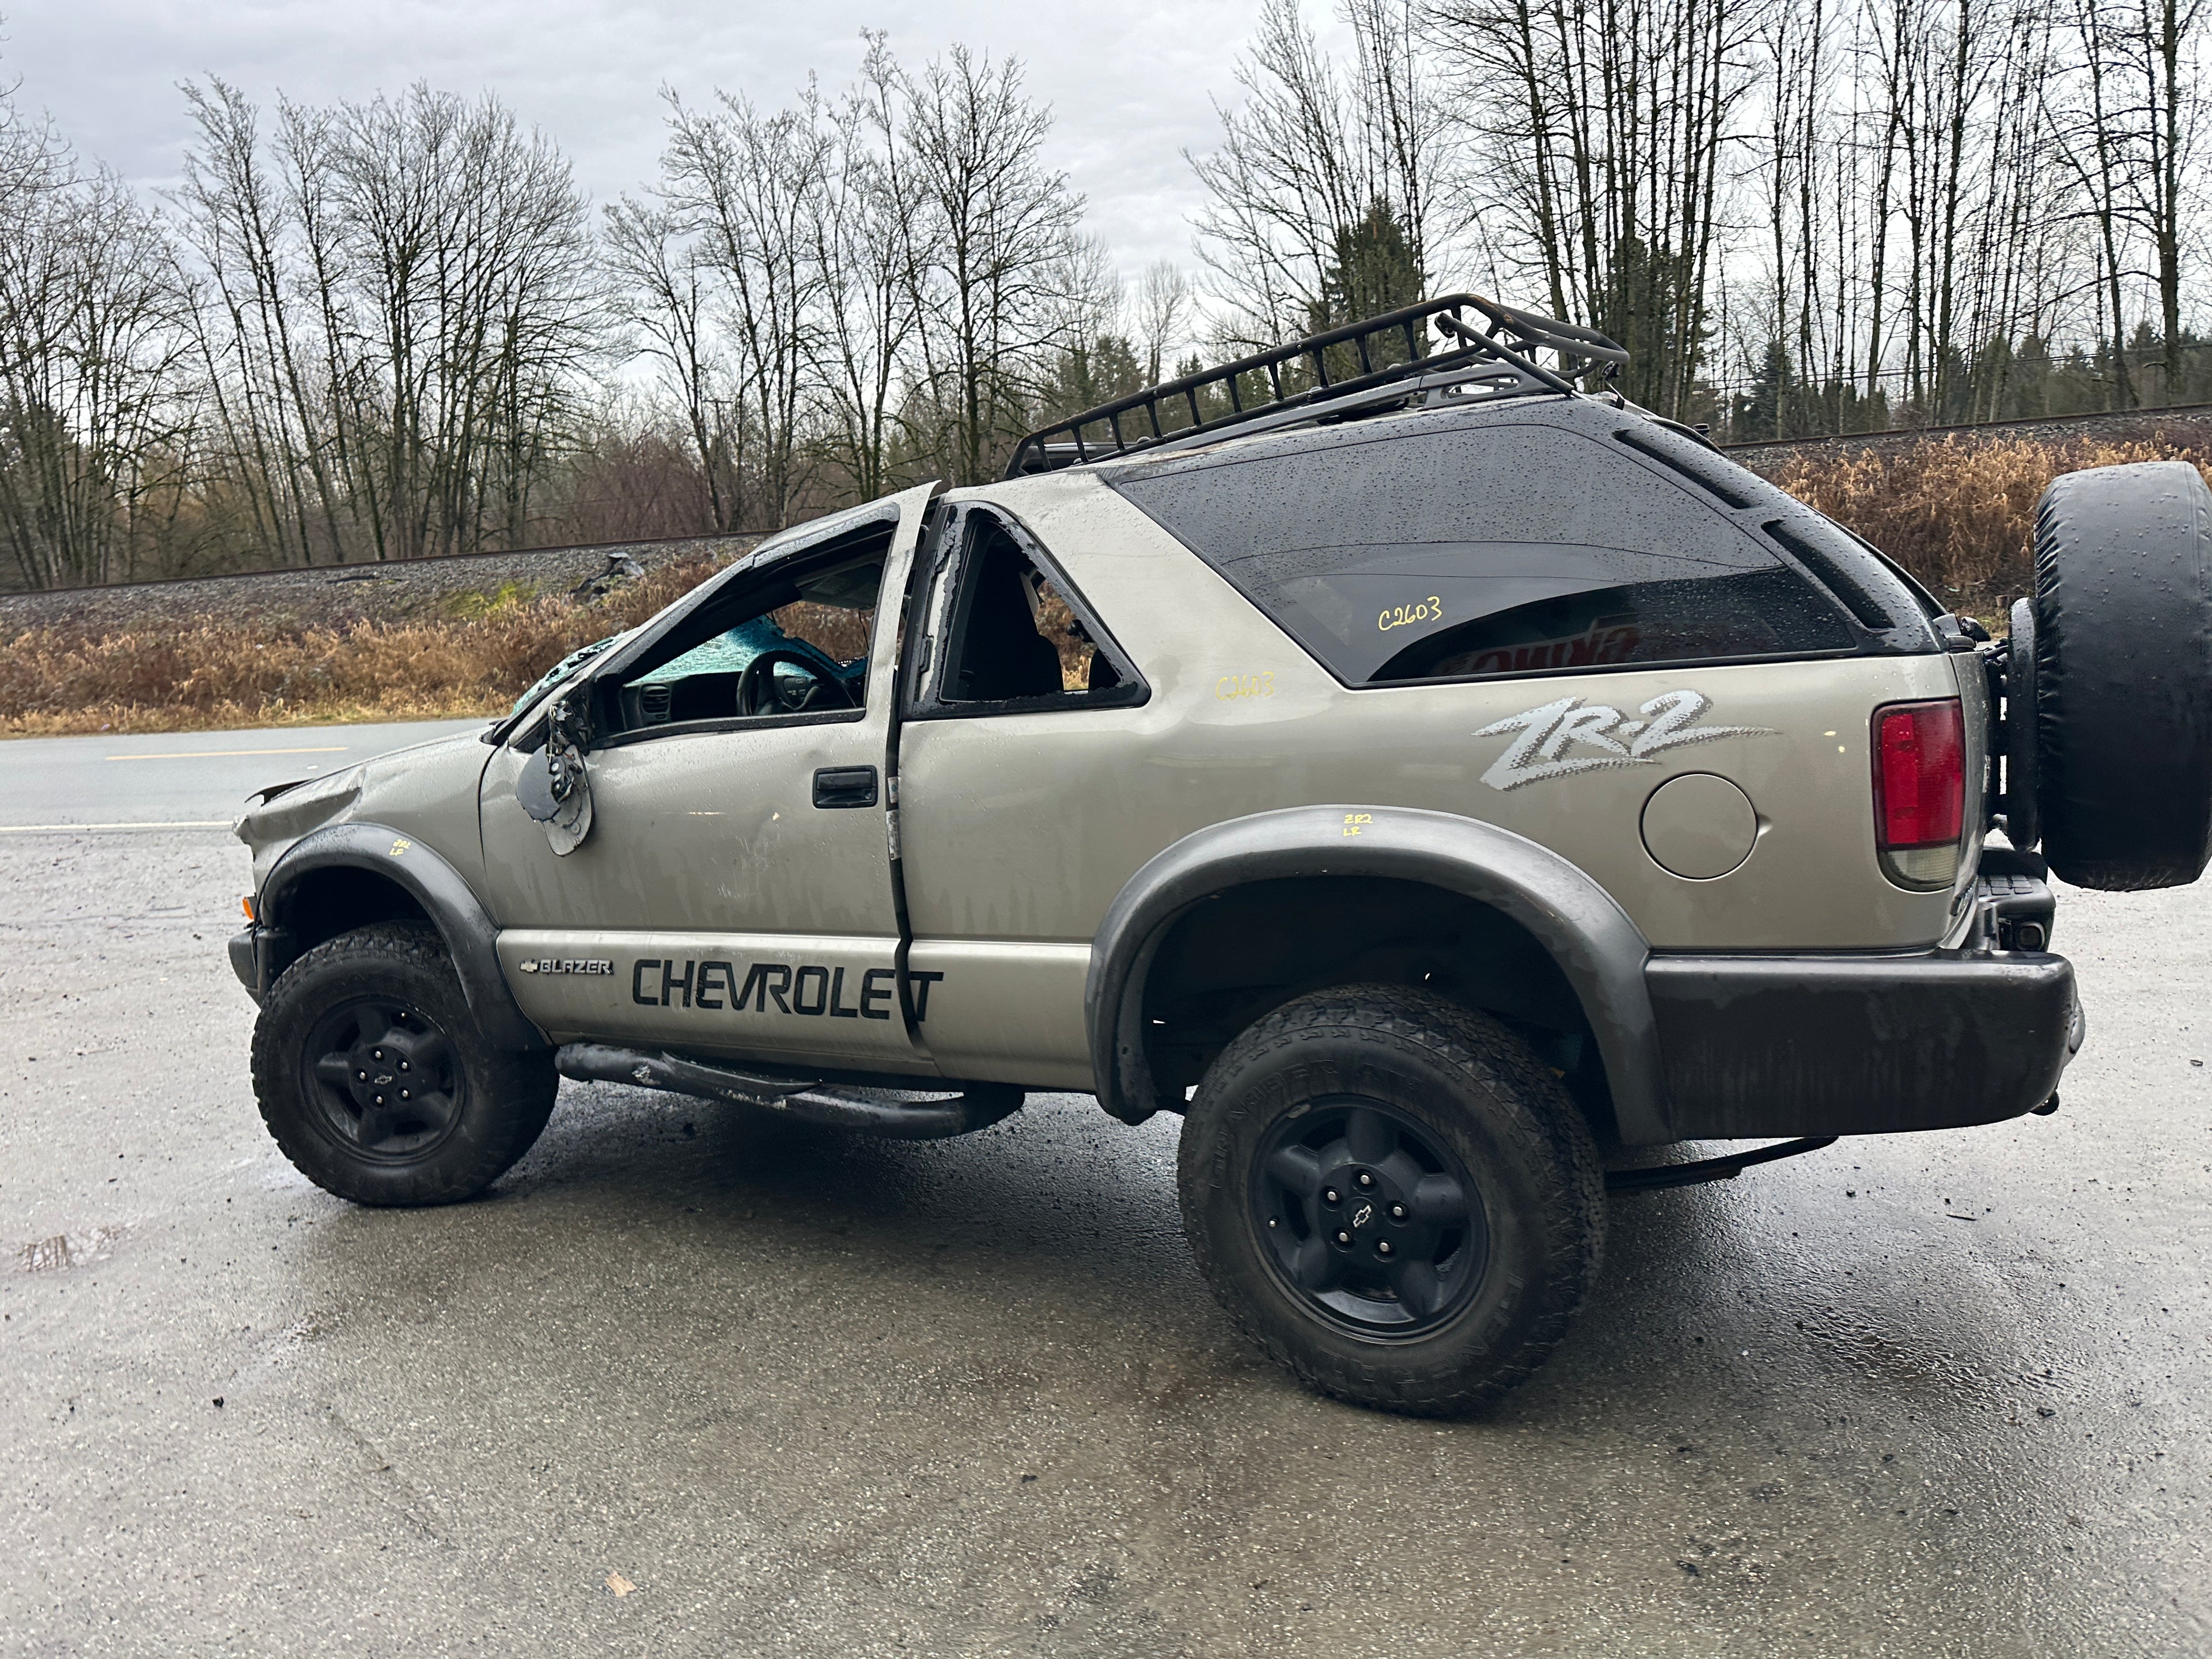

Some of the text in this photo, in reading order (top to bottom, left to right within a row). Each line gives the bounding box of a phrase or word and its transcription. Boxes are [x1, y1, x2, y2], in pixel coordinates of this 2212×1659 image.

[1378, 596, 1442, 631] C2603
[1216, 671, 1275, 700] C2603
[1343, 825, 1362, 837] LR
[389, 847, 404, 857] LF
[539, 959, 613, 976] BLAZER
[632, 959, 945, 1022] CHEVROLET
